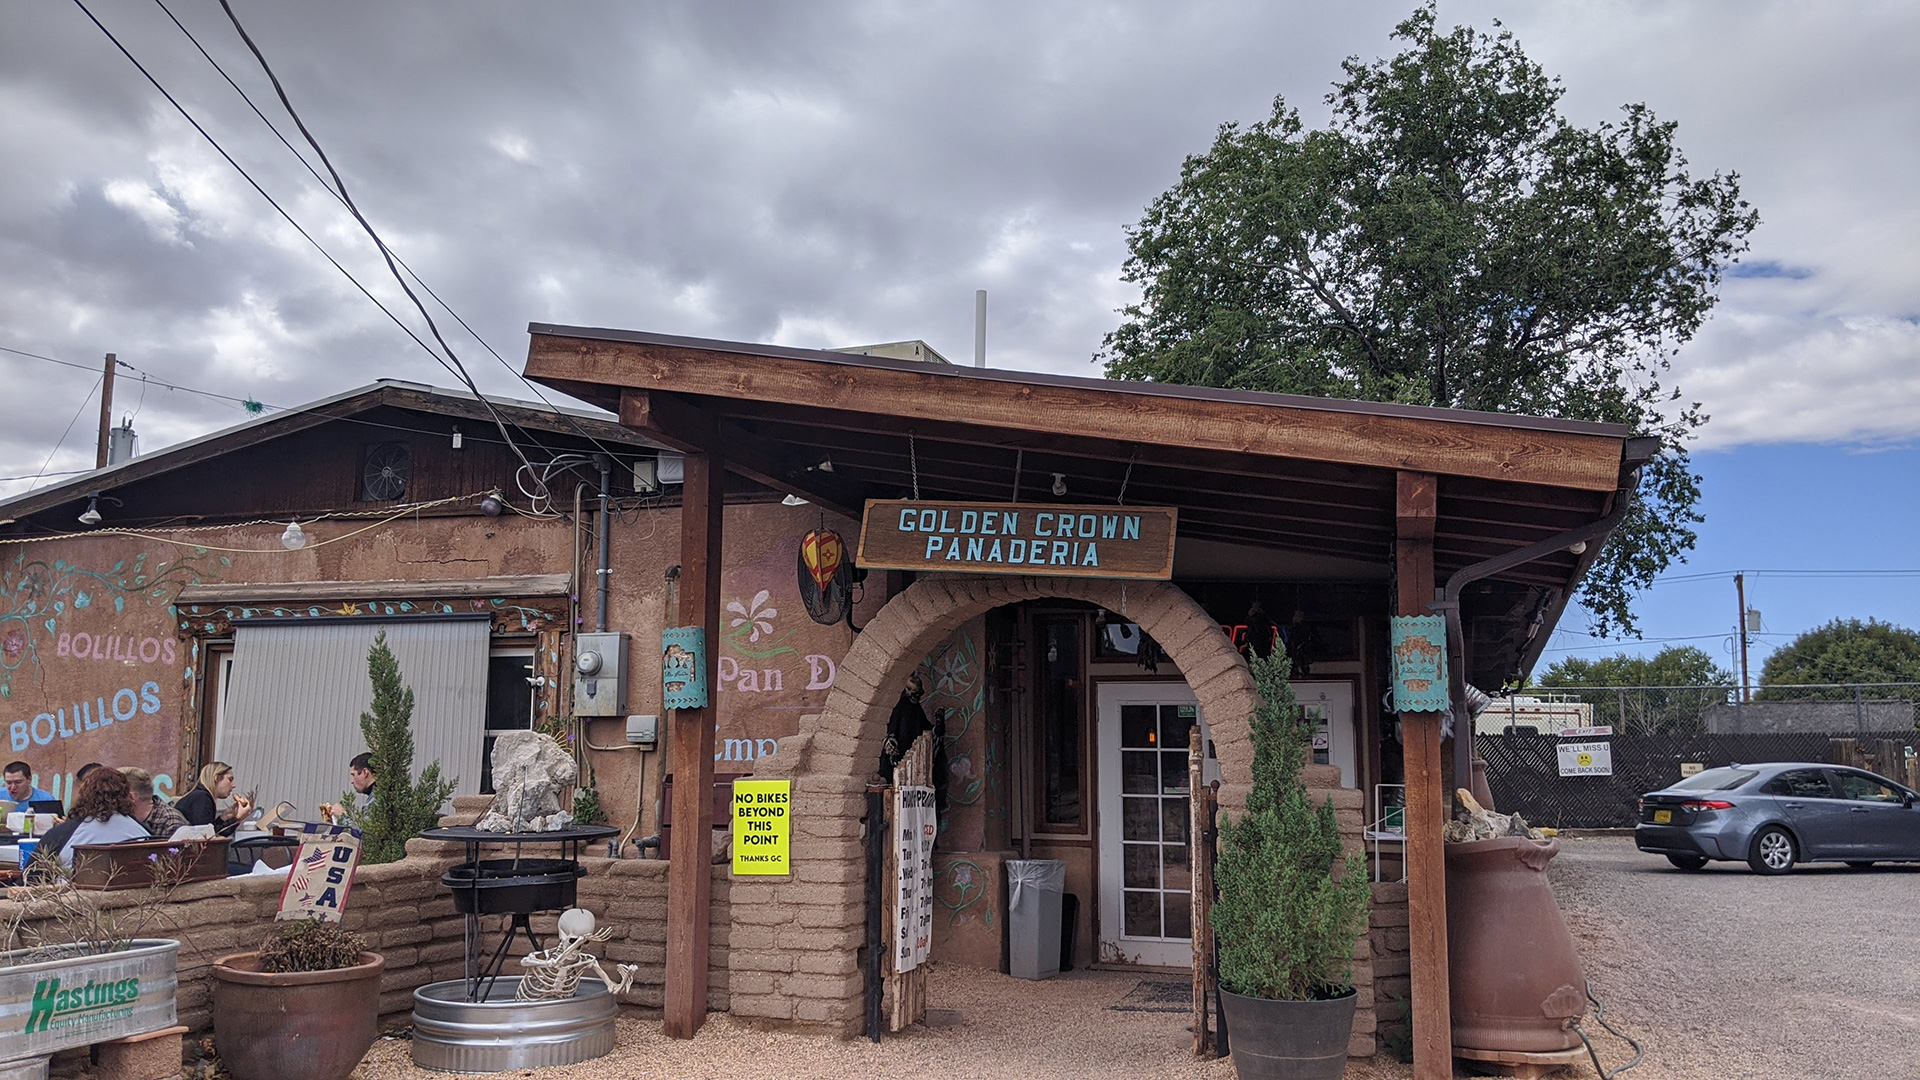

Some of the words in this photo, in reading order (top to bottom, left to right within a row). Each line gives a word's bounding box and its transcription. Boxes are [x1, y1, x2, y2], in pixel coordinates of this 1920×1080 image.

[898, 508, 1019, 535] GOLDEN
[1034, 512, 1141, 540] CROWN
[925, 535, 1099, 567] PANADERIA
[57, 633, 176, 665] BOLILLOS
[9, 681, 161, 752] BOLILLOS
[736, 794, 753, 803] NO
[757, 793, 788, 803] BIKES
[739, 807, 784, 817] BEYOND
[744, 835, 778, 845] POINT
[747, 821, 772, 831] THIS
[315, 846, 353, 908] USA
[25, 977, 140, 1035] Hastings
[50, 1015, 76, 1030] Equity
[77, 1006, 133, 1024] Manufacturing
